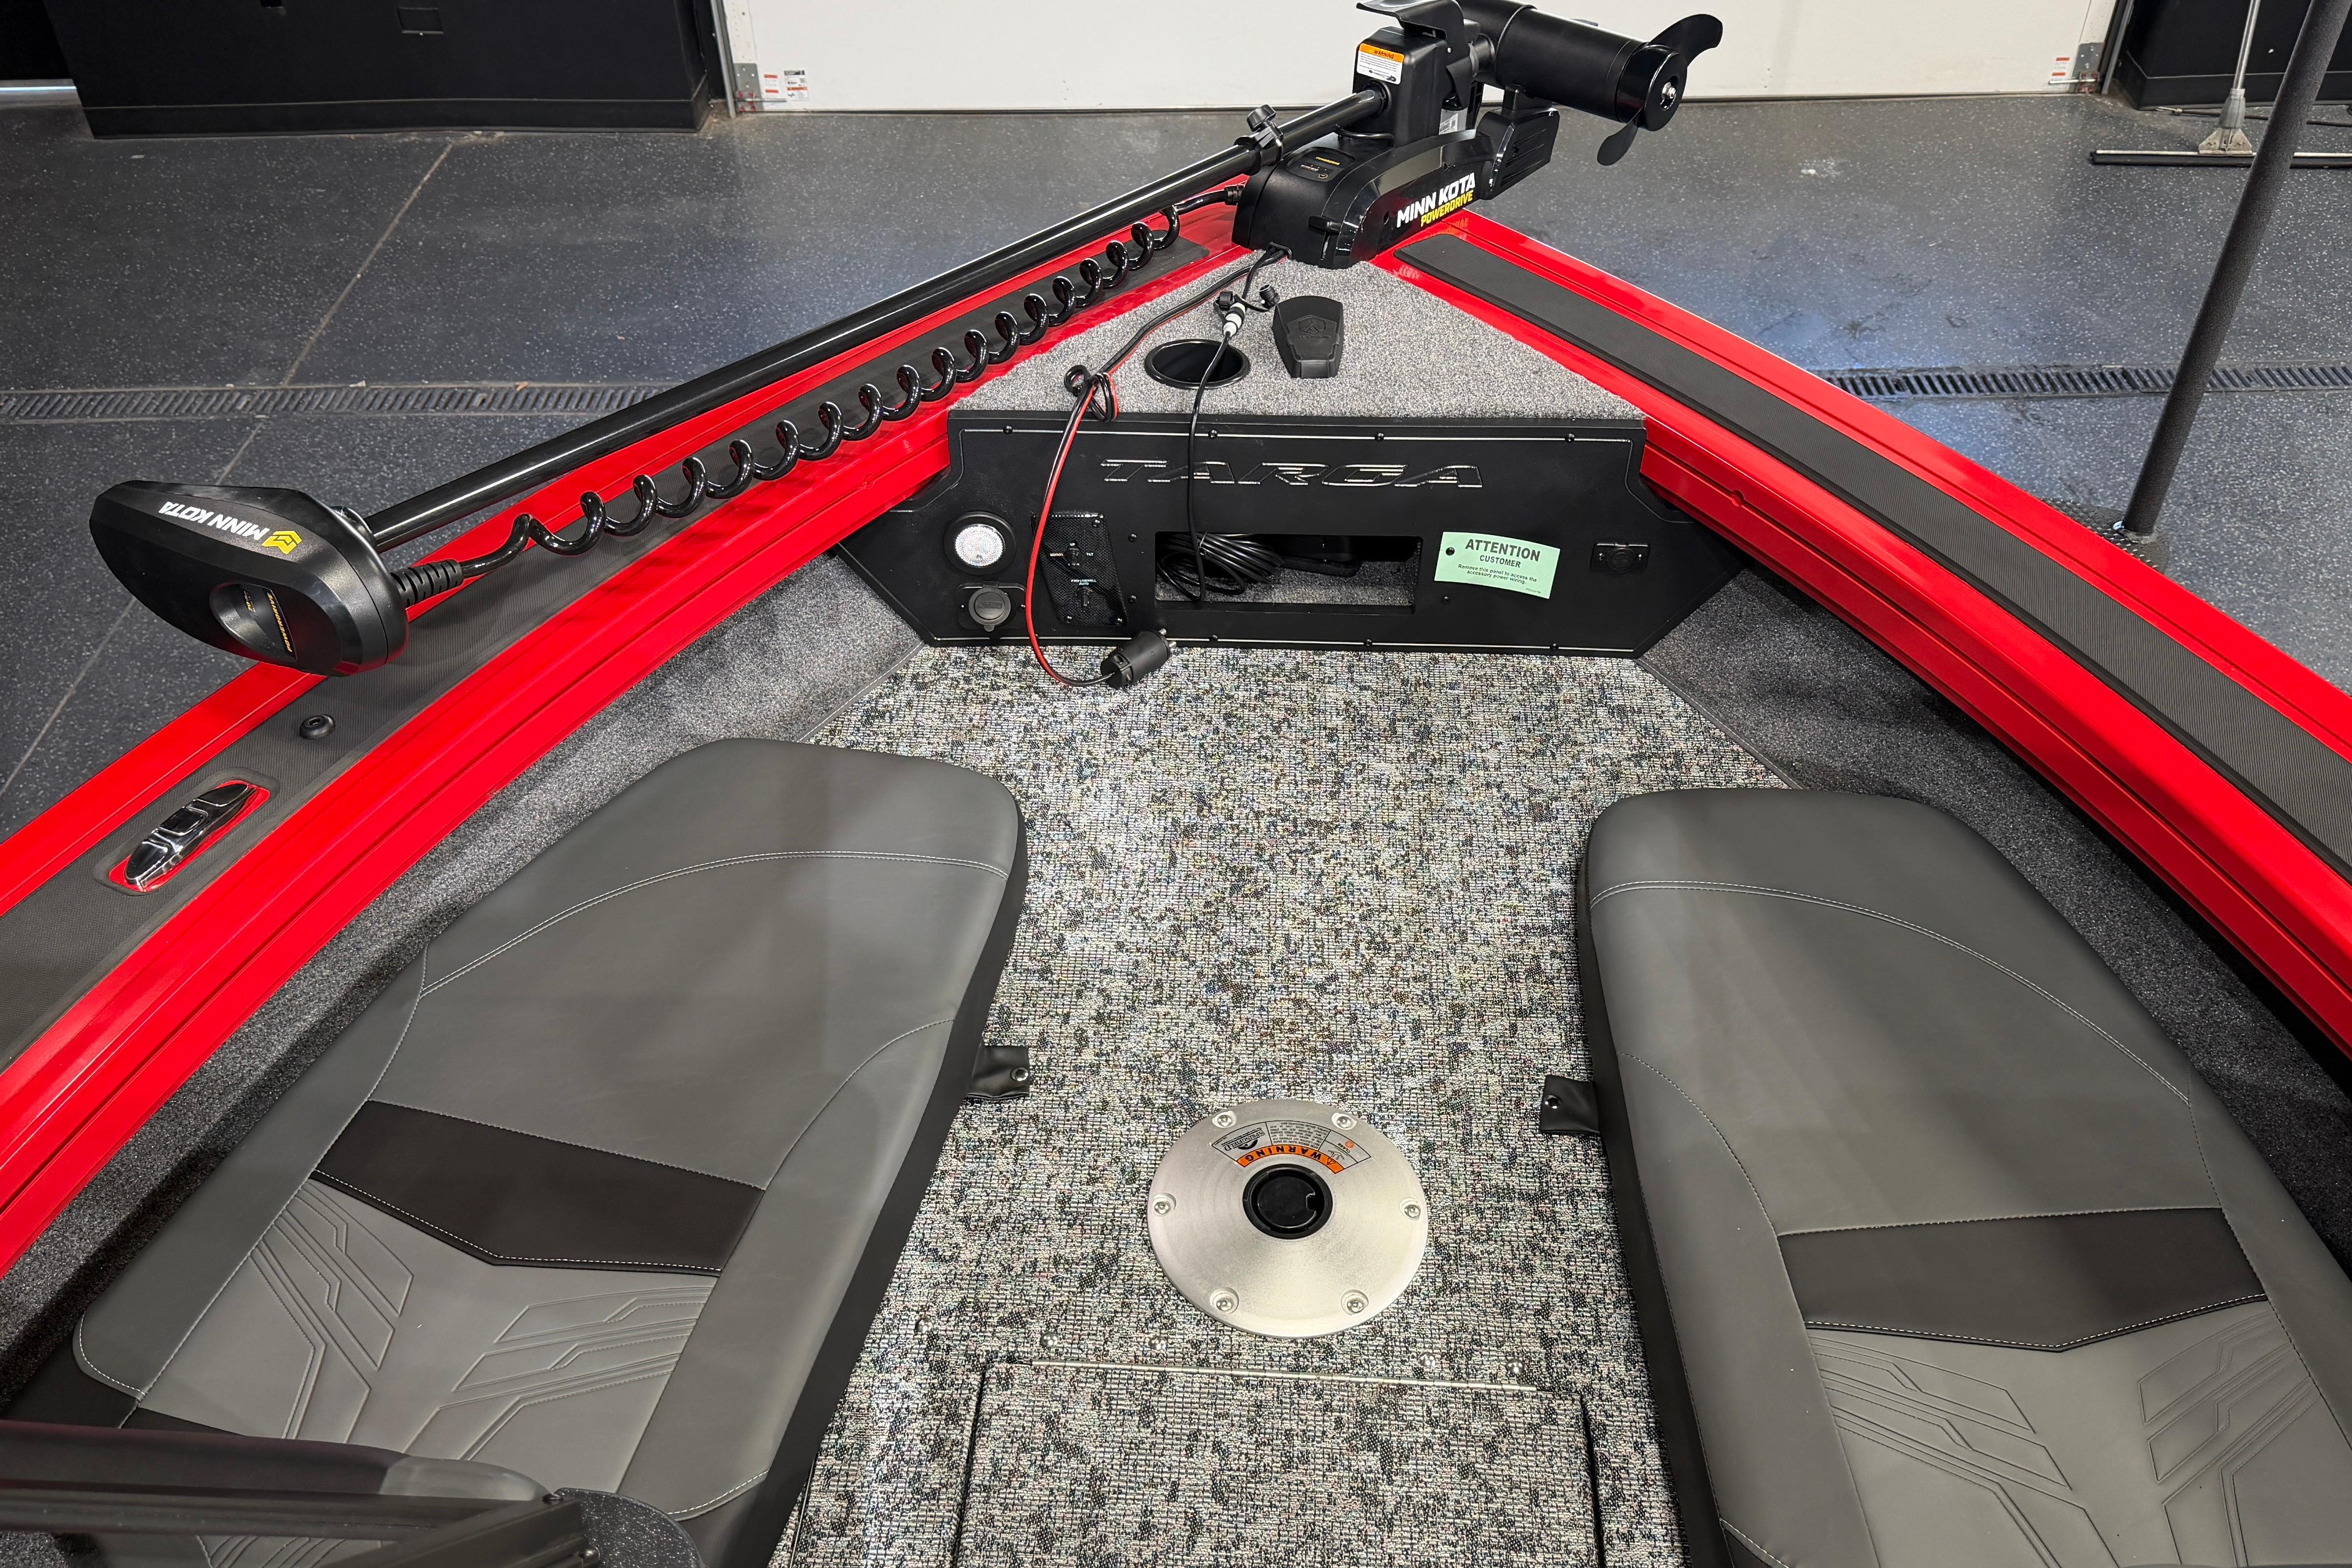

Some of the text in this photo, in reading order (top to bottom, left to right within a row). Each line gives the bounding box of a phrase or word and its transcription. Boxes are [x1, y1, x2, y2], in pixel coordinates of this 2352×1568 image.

[1397, 172, 1476, 228] MINN KOTA
[1420, 190, 1474, 227] POWERDRIVE
[1100, 459, 1483, 488] TARGA
[159, 501, 270, 541] MINN KOTA
[1465, 539, 1541, 562] ATTENTION
[1480, 555, 1521, 568] CUSTOMER
[267, 592, 293, 652] POWERDRIVE
[1224, 1130, 1265, 1151] SPRINGFIELD
[1245, 1146, 1322, 1161] WARNING
